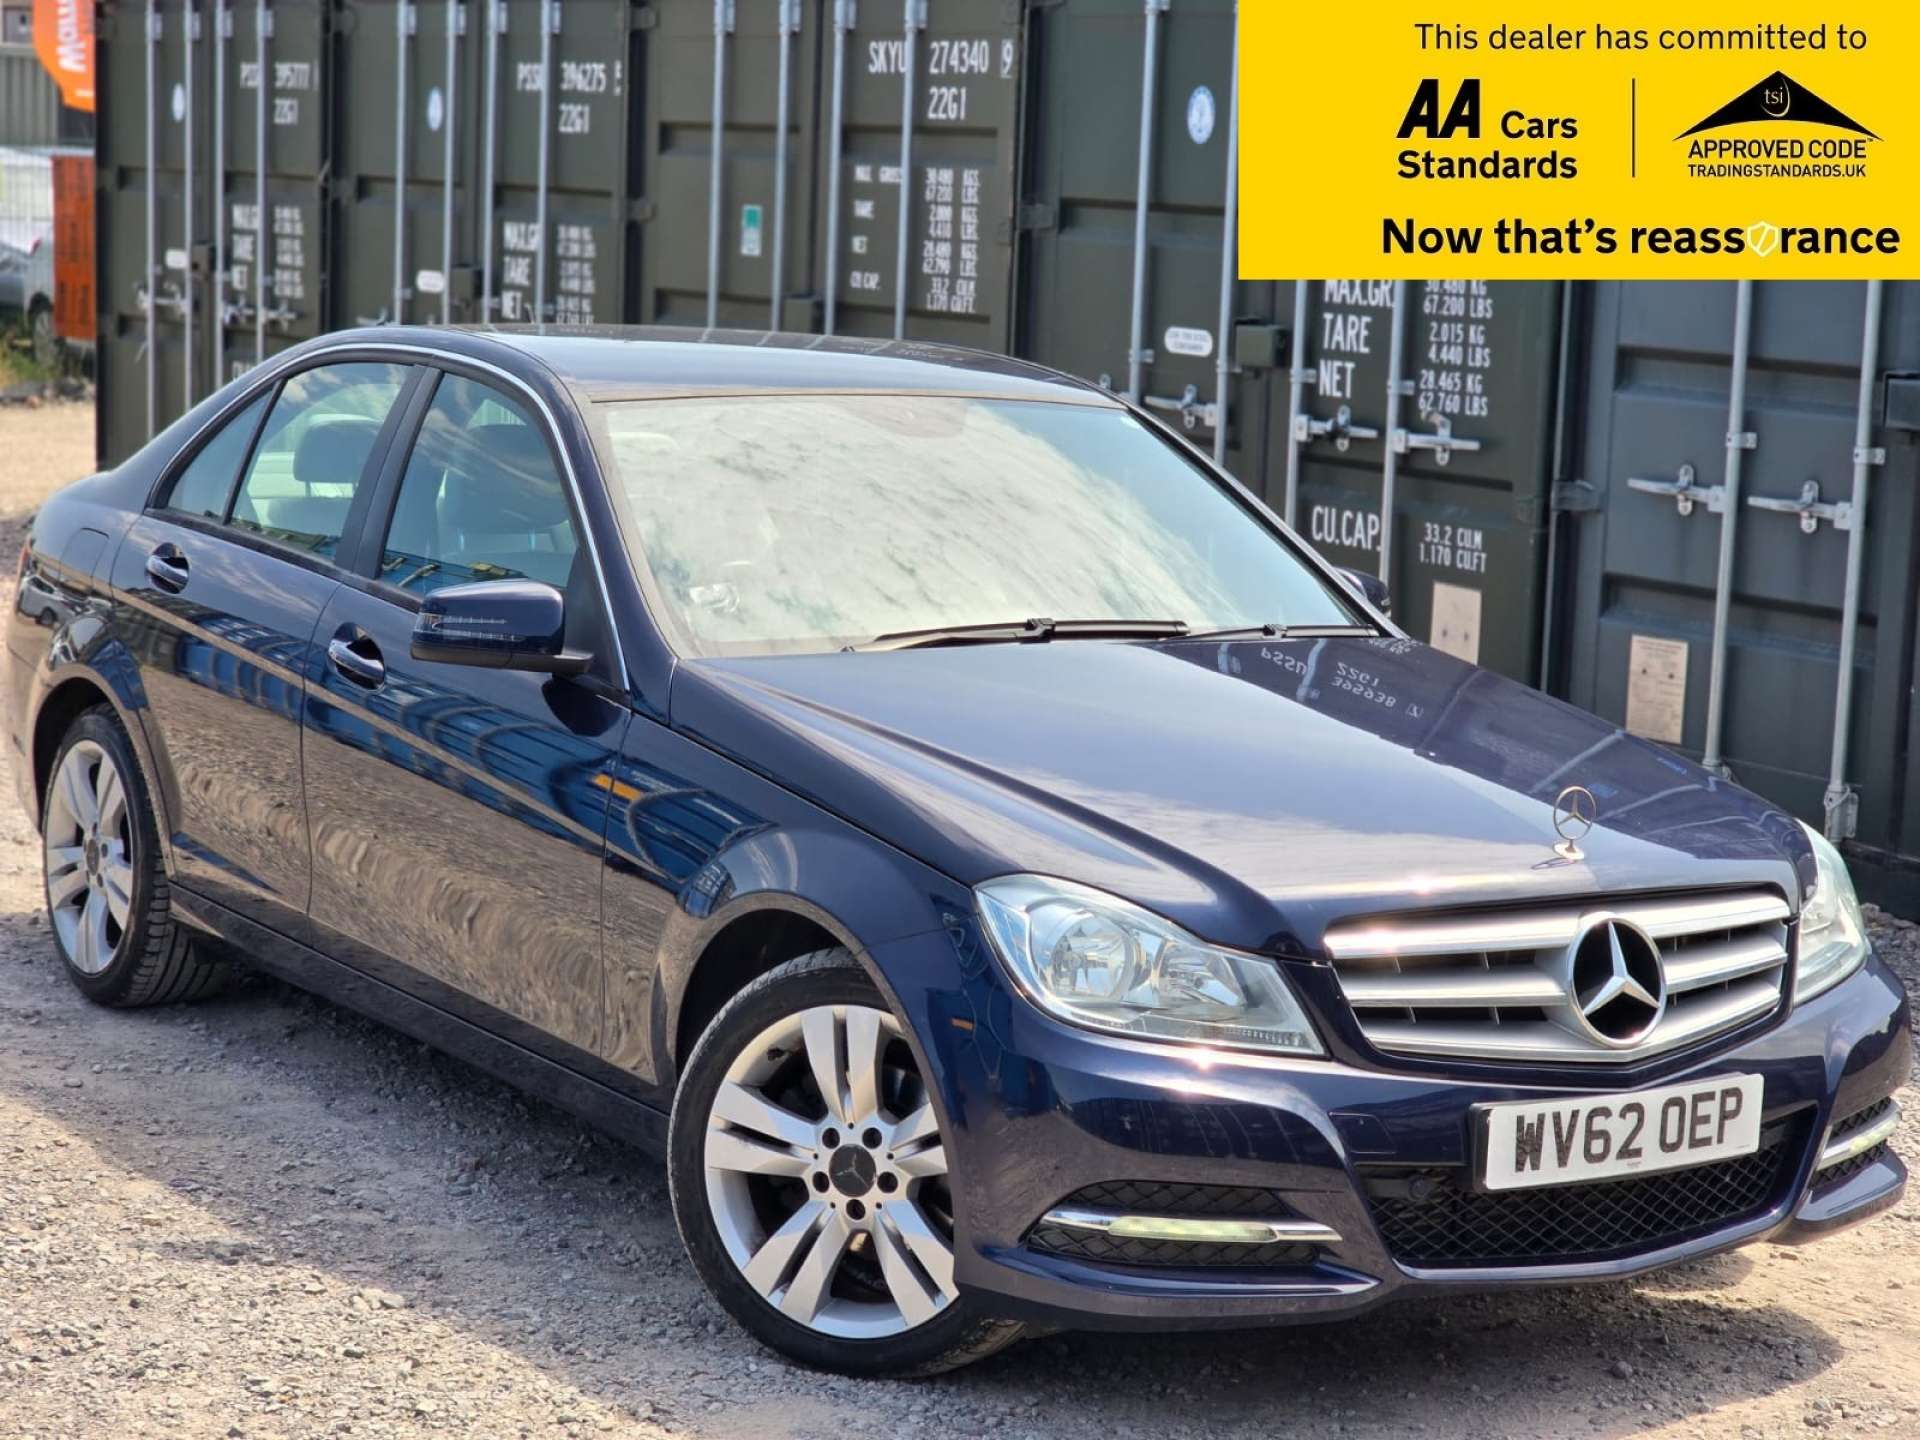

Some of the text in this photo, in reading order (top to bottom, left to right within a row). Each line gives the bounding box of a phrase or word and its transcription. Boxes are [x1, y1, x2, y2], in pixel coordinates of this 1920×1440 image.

[929, 40, 989, 74] 274340
[1001, 40, 1014, 77] 9
[928, 86, 967, 119] 22G1
[559, 103, 590, 133] 22G1
[1423, 295, 1493, 319] 67.200 LBS
[1323, 312, 1372, 354] TARE
[1429, 322, 1486, 345] 2.015 KG
[1428, 344, 1491, 367] 4.440 LBS
[1319, 358, 1355, 398] NET
[1419, 369, 1483, 394] 28.465 KG
[1464, 396, 1489, 416] LBS
[1424, 522, 1452, 546] 33.2
[1420, 543, 1451, 568] 1.170
[1515, 1087, 1743, 1173] WV62 OEP
